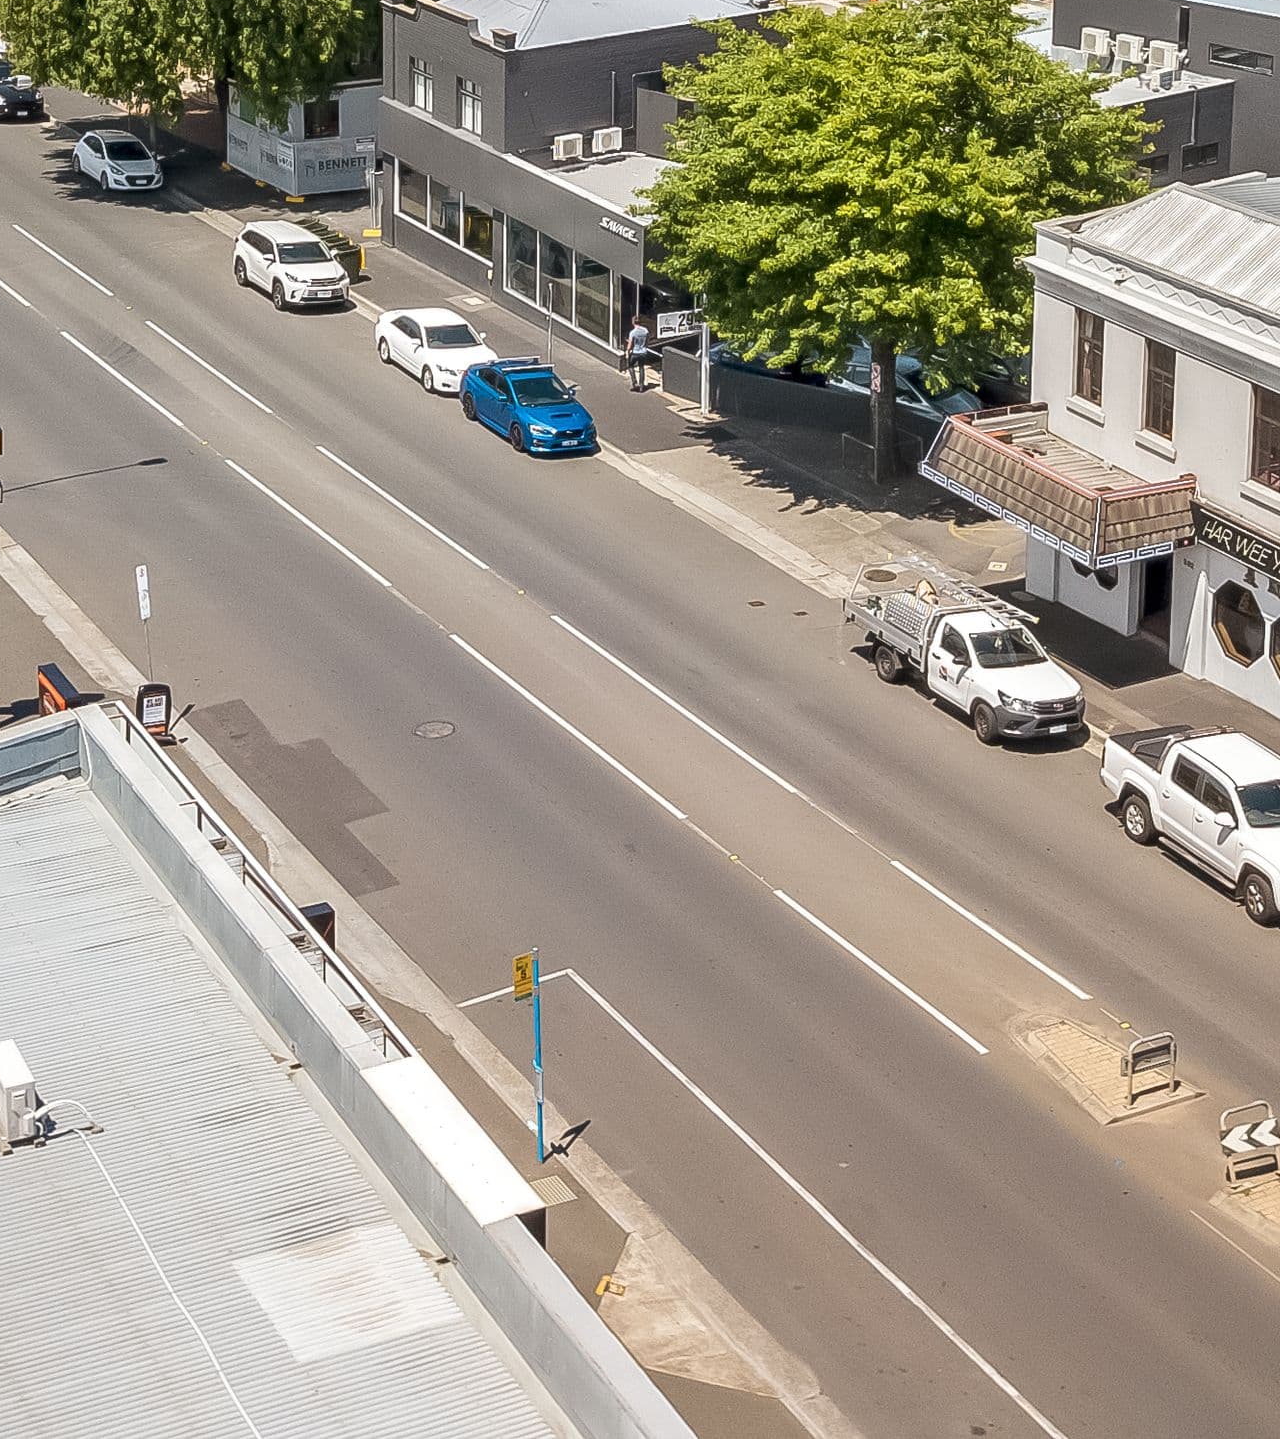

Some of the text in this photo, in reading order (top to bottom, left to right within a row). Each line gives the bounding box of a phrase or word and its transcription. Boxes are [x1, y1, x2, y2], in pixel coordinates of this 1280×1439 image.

[318, 156, 368, 171] BENNETT
[1202, 520, 1233, 551] HAR
[1235, 536, 1272, 567] WEE
